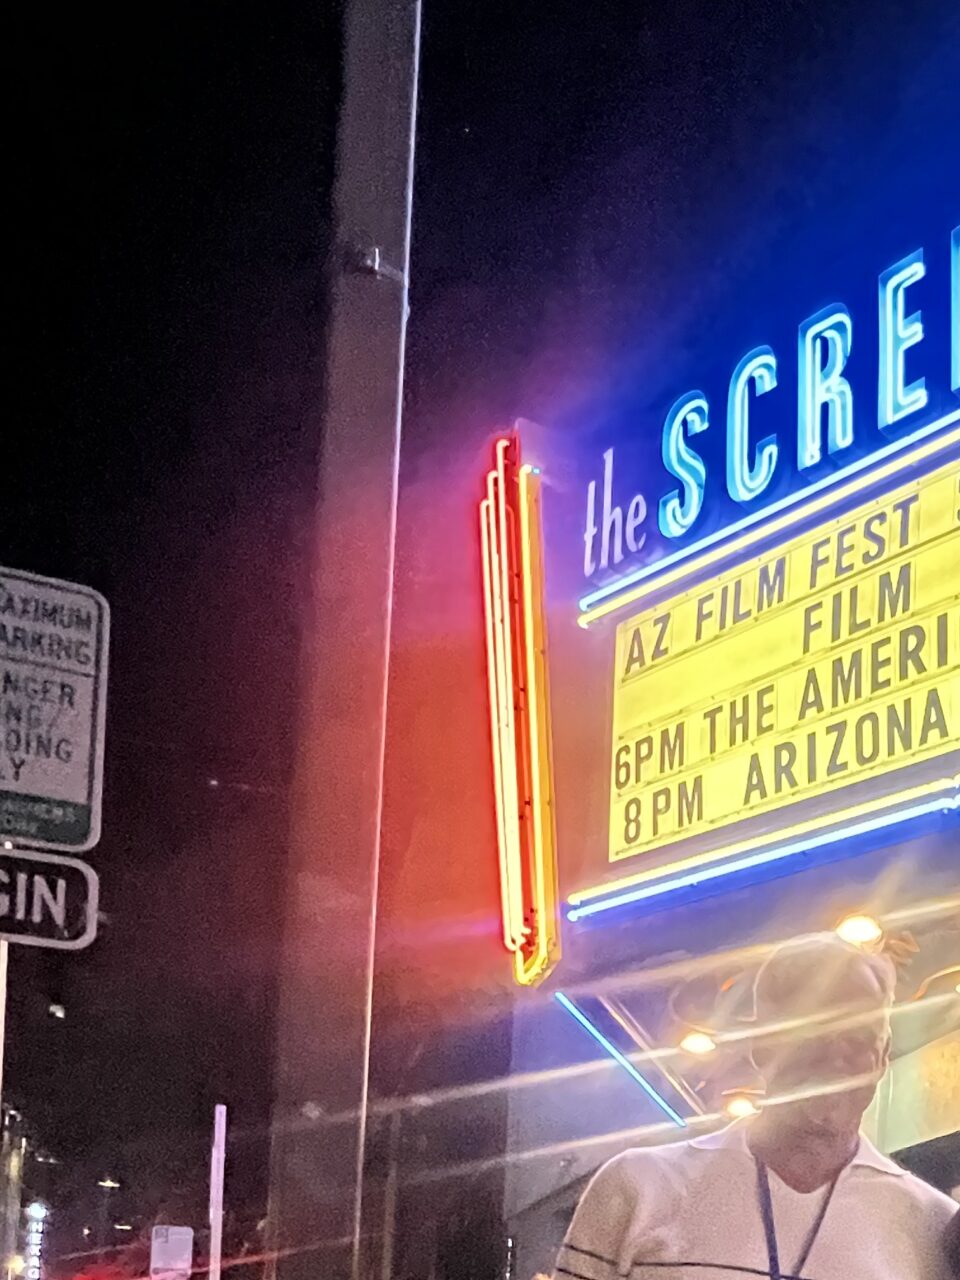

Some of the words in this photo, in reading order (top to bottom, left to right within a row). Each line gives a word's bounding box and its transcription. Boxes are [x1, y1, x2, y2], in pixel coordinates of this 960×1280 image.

[582, 446, 647, 577] the
[625, 611, 670, 674] AZ
[695, 557, 786, 641] FILM
[809, 493, 920, 590] FEST
[801, 561, 912, 655] FILM
[613, 721, 685, 790] 6PM
[703, 683, 776, 755] THE
[623, 774, 704, 845] 8PM
[743, 686, 950, 806] ARIZONA
